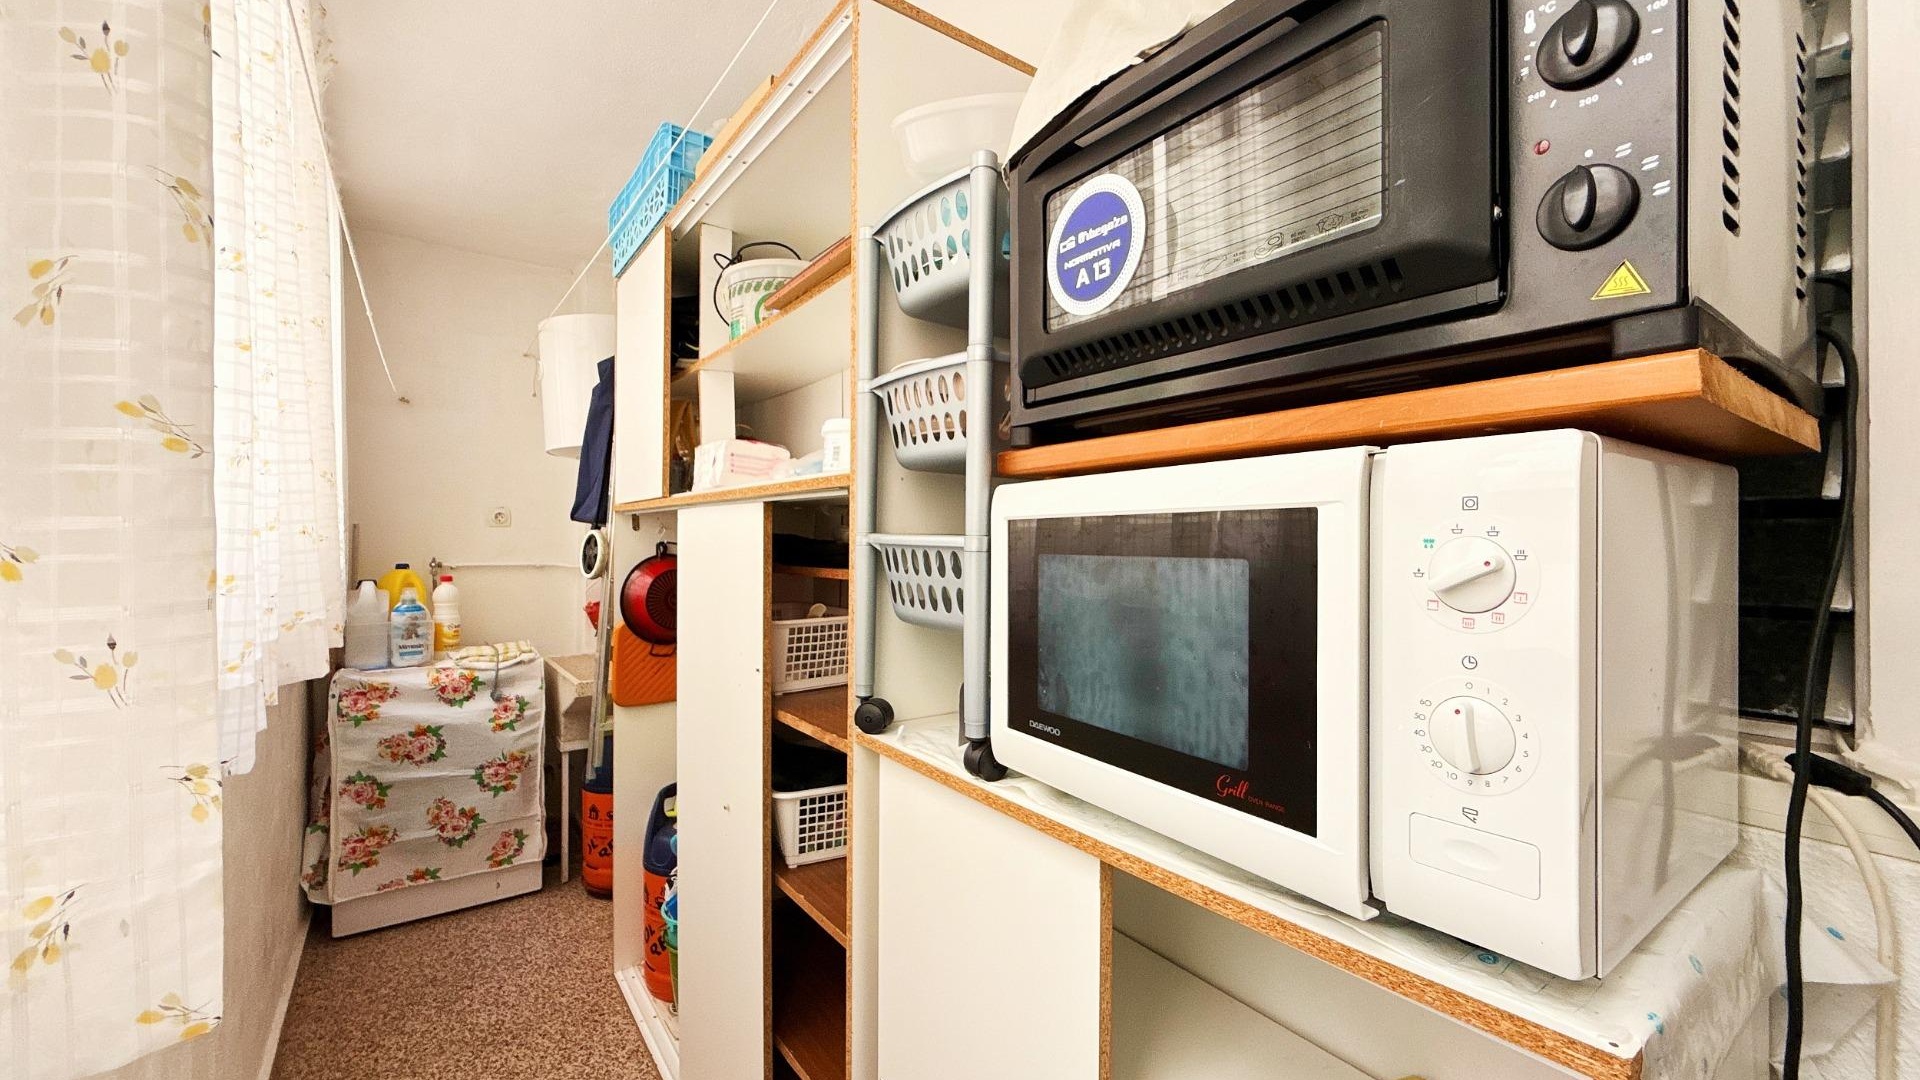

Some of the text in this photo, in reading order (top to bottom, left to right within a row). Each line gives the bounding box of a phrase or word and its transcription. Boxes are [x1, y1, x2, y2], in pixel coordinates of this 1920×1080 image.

[1578, 94, 1599, 107] 200
[1075, 257, 1111, 289] A 13
[1419, 699, 1432, 707] 60
[1502, 698, 1509, 706] 2
[1413, 713, 1426, 721] 50
[1029, 719, 1061, 736] DAEWOO
[1413, 729, 1426, 737] 40
[1421, 745, 1433, 753] 30
[1431, 760, 1443, 769] 20
[1515, 765, 1522, 773] 6
[1446, 772, 1458, 780] 10
[1216, 774, 1249, 799] Grill
